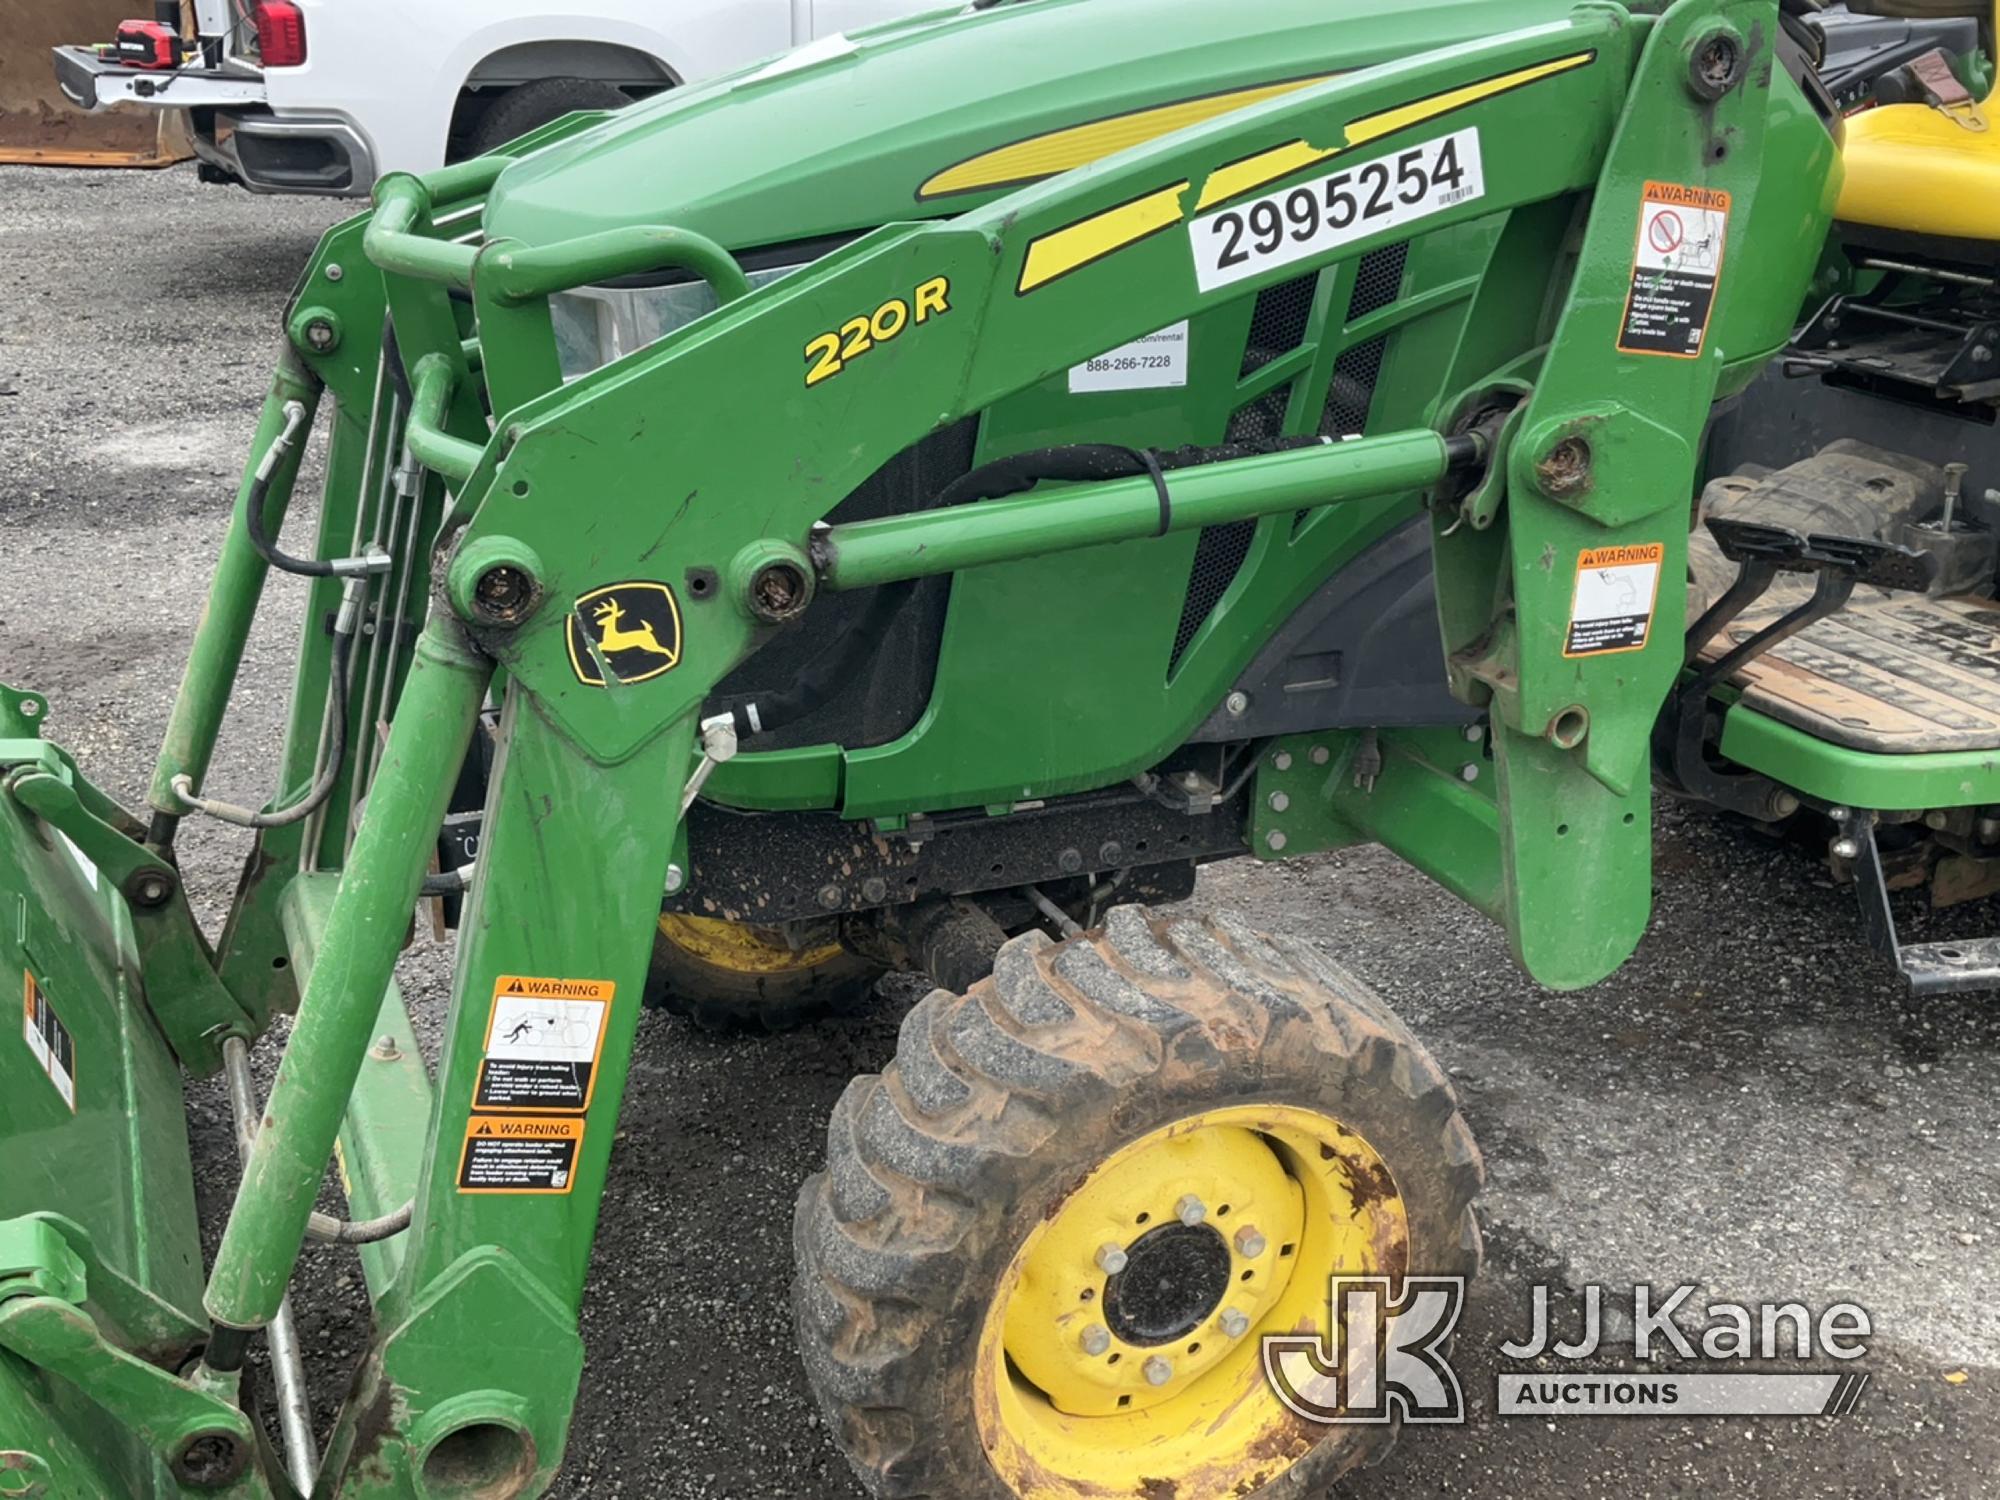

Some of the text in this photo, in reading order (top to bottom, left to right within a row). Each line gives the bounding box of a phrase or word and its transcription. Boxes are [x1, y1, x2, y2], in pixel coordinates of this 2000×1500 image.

[1212, 137, 1464, 270] 2995254
[1661, 187, 1725, 207] WARNING
[1086, 355, 1171, 372] 888-266-7228
[1597, 547, 1657, 563] WARNING
[529, 982, 599, 996] WARNING
[501, 1123, 570, 1135] WARNING
